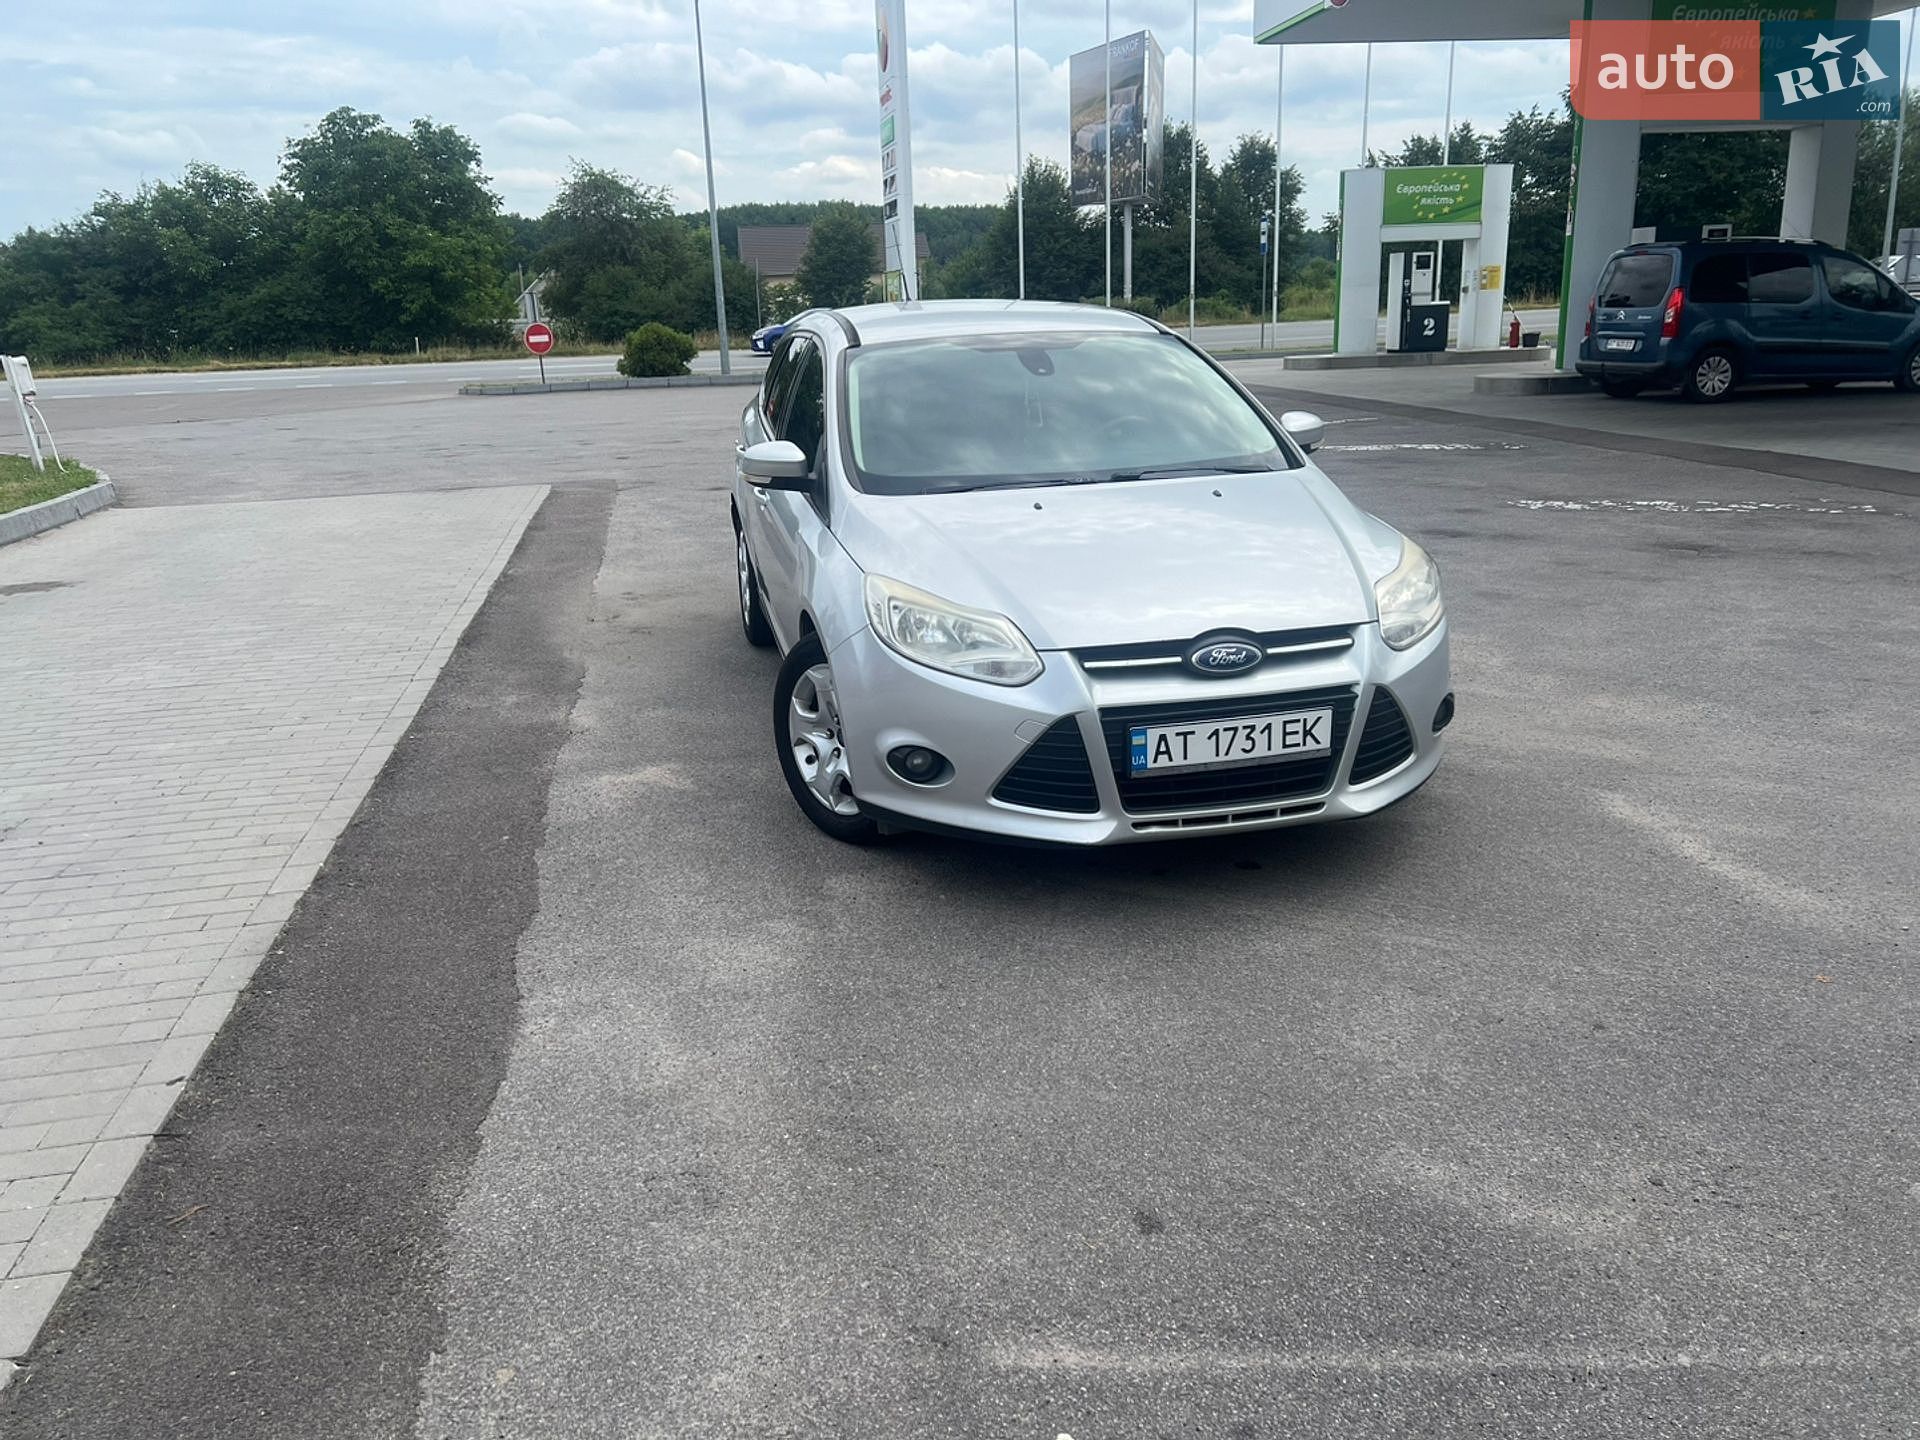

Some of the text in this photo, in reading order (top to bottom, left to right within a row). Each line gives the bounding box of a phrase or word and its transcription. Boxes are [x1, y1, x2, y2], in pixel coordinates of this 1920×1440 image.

[1396, 182, 1461, 195] Європейська
[1420, 195, 1455, 206] якість
[1423, 317, 1436, 336] 2
[1209, 647, 1247, 666] Ford
[1152, 716, 1323, 764] AT 1731 EK
[1131, 755, 1146, 765] UA
